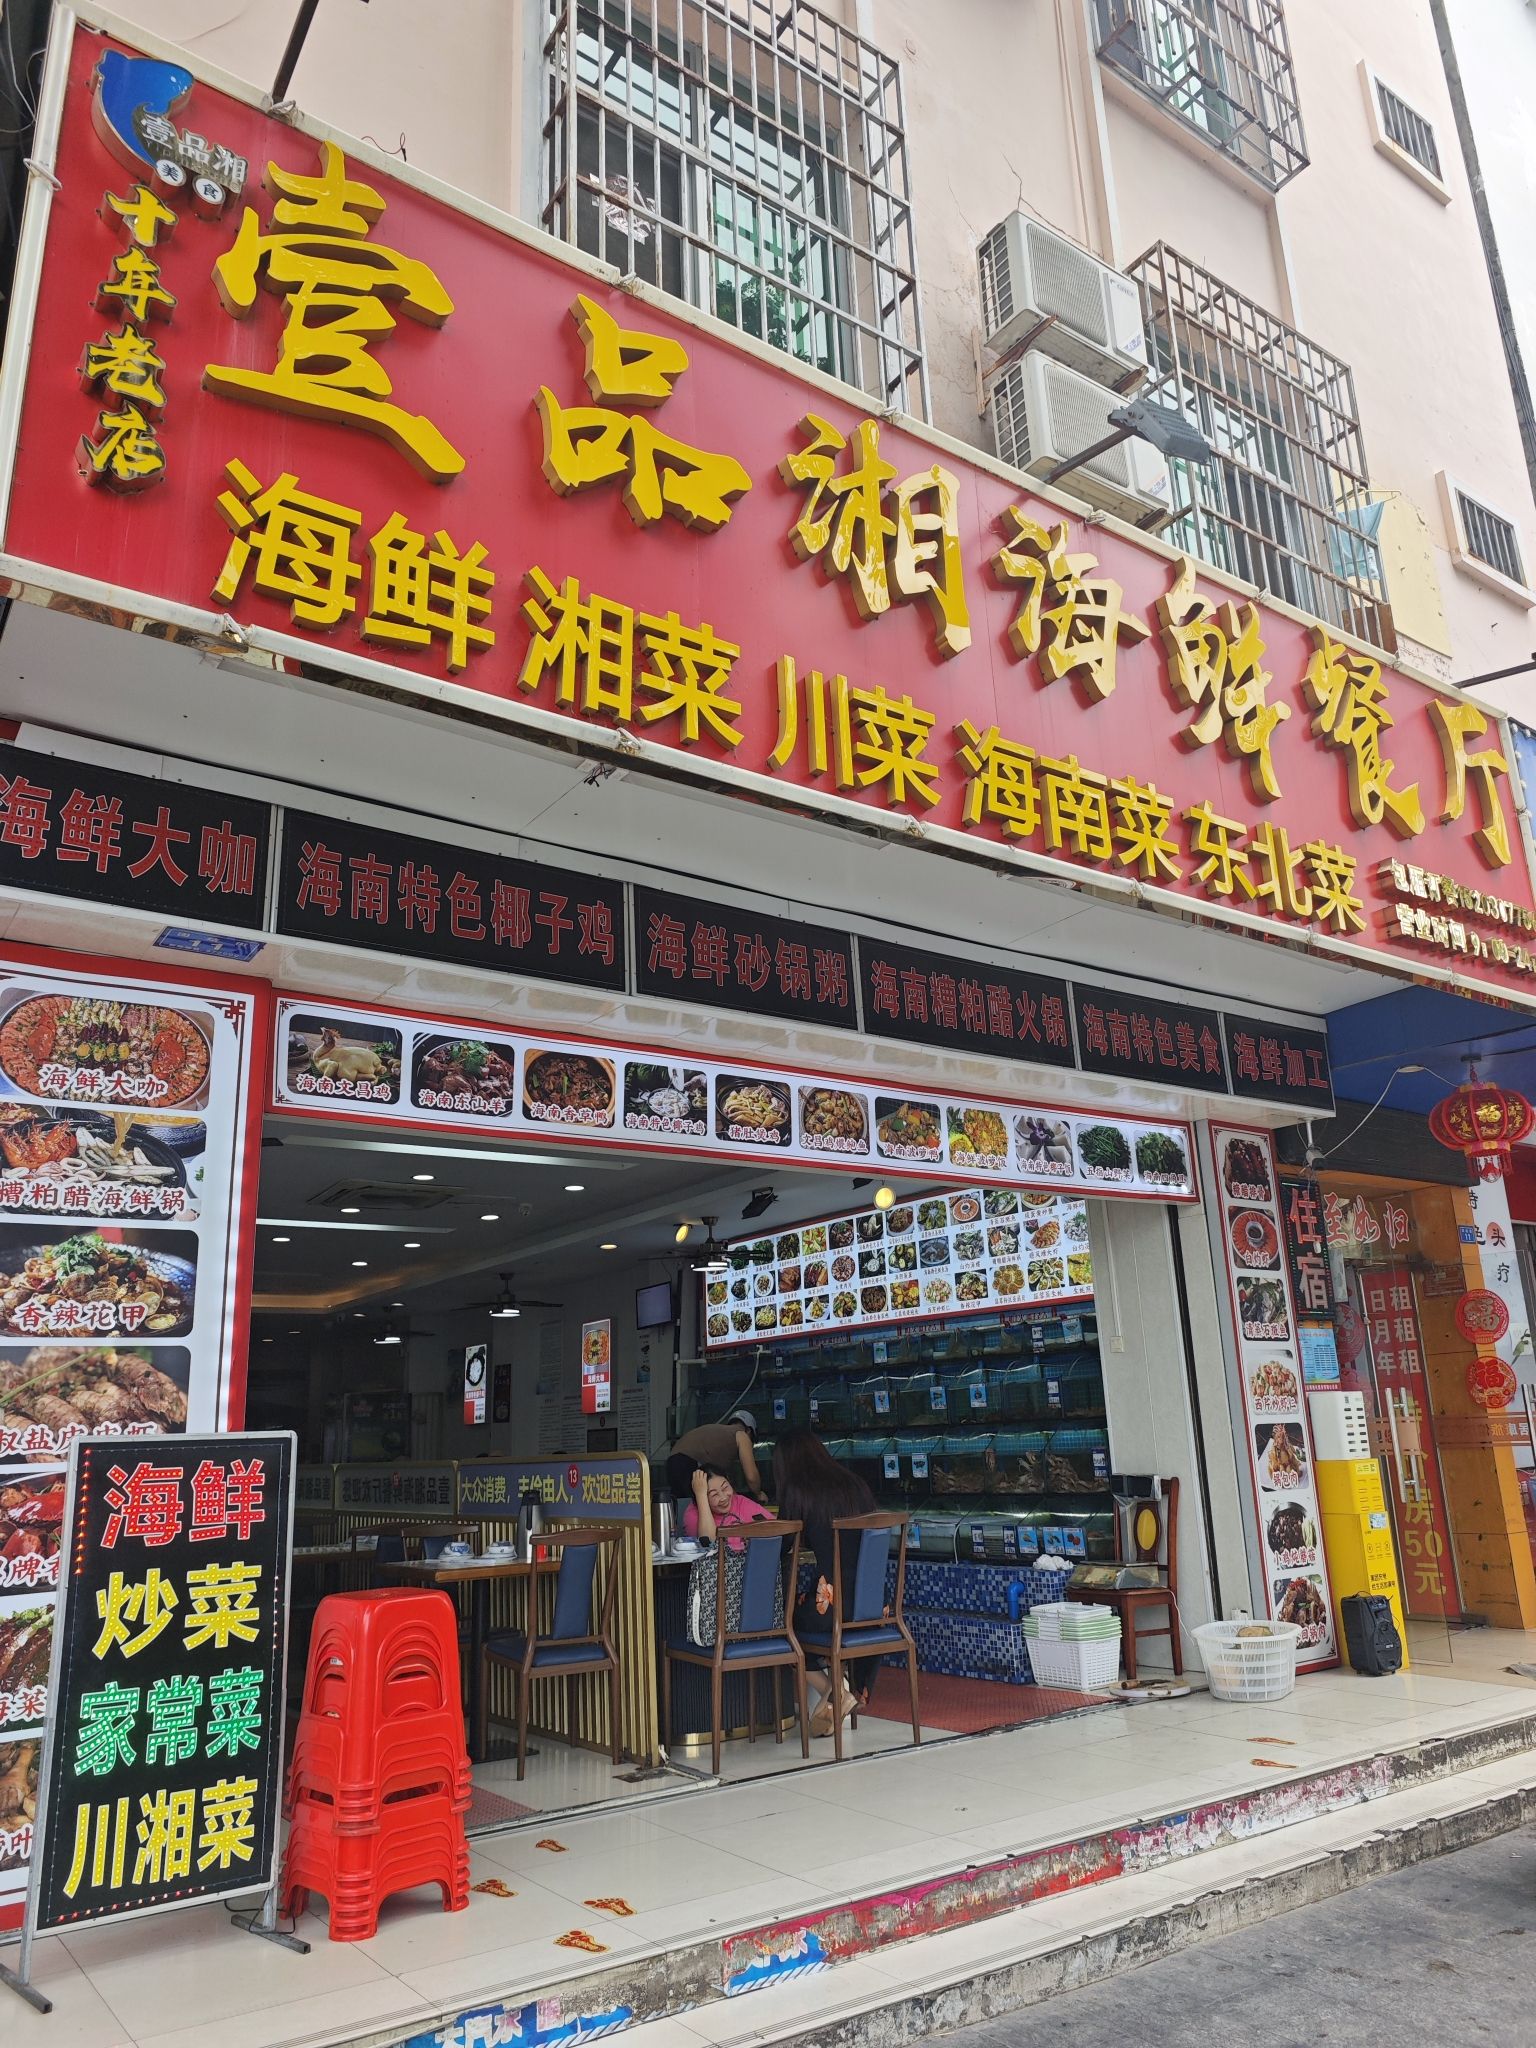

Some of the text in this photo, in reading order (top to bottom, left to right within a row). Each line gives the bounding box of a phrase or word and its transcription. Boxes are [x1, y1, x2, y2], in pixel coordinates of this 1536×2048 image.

[141, 113, 247, 183] 壹品湘
[162, 163, 219, 200] 美食
[82, 184, 177, 486] 十年老店
[204, 139, 1512, 868] 壹品湘海鲜餐厅
[211, 458, 1366, 935] 海鲜 湘菜 川菜 海南菜 东北菜
[0, 774, 258, 896] 海鲜大咖
[296, 840, 616, 966] 海南特色椰子鸡
[647, 912, 849, 1009] 海鲜砂锅粥
[870, 960, 1069, 1048] 海南糟粕醋火锅
[1082, 1003, 1222, 1076] 海南特色美食
[1233, 1031, 1329, 1089] 海鲜加工
[41, 1065, 167, 1100] 海鲜大咖
[296, 1073, 392, 1100] 海南文昌鸡
[418, 1089, 507, 1114] 海南东山羊
[530, 1102, 610, 1126] 海南香草鸭
[625, 1112, 706, 1136] 海南特色椰子鸡
[728, 1125, 781, 1144] 猪肚煲鸡
[0, 1180, 186, 1213] 糟粕醋海鲜锅
[1243, 1249, 1270, 1268] 白灼虾
[1289, 1187, 1328, 1310] 住宿
[18, 1301, 147, 1329] 香辣花甲
[1369, 1285, 1413, 1313] 日租
[1374, 1317, 1418, 1346] 月租
[1377, 1348, 1422, 1376] 年租
[1272, 1470, 1299, 1489] 锅包肉
[100, 1458, 267, 1550] 海鲜
[92, 1561, 263, 1661] 炒菜
[1296, 1621, 1327, 1646] 回锅肉
[74, 1667, 265, 1778] 家常菜
[63, 1776, 260, 1900] 川湘菜
